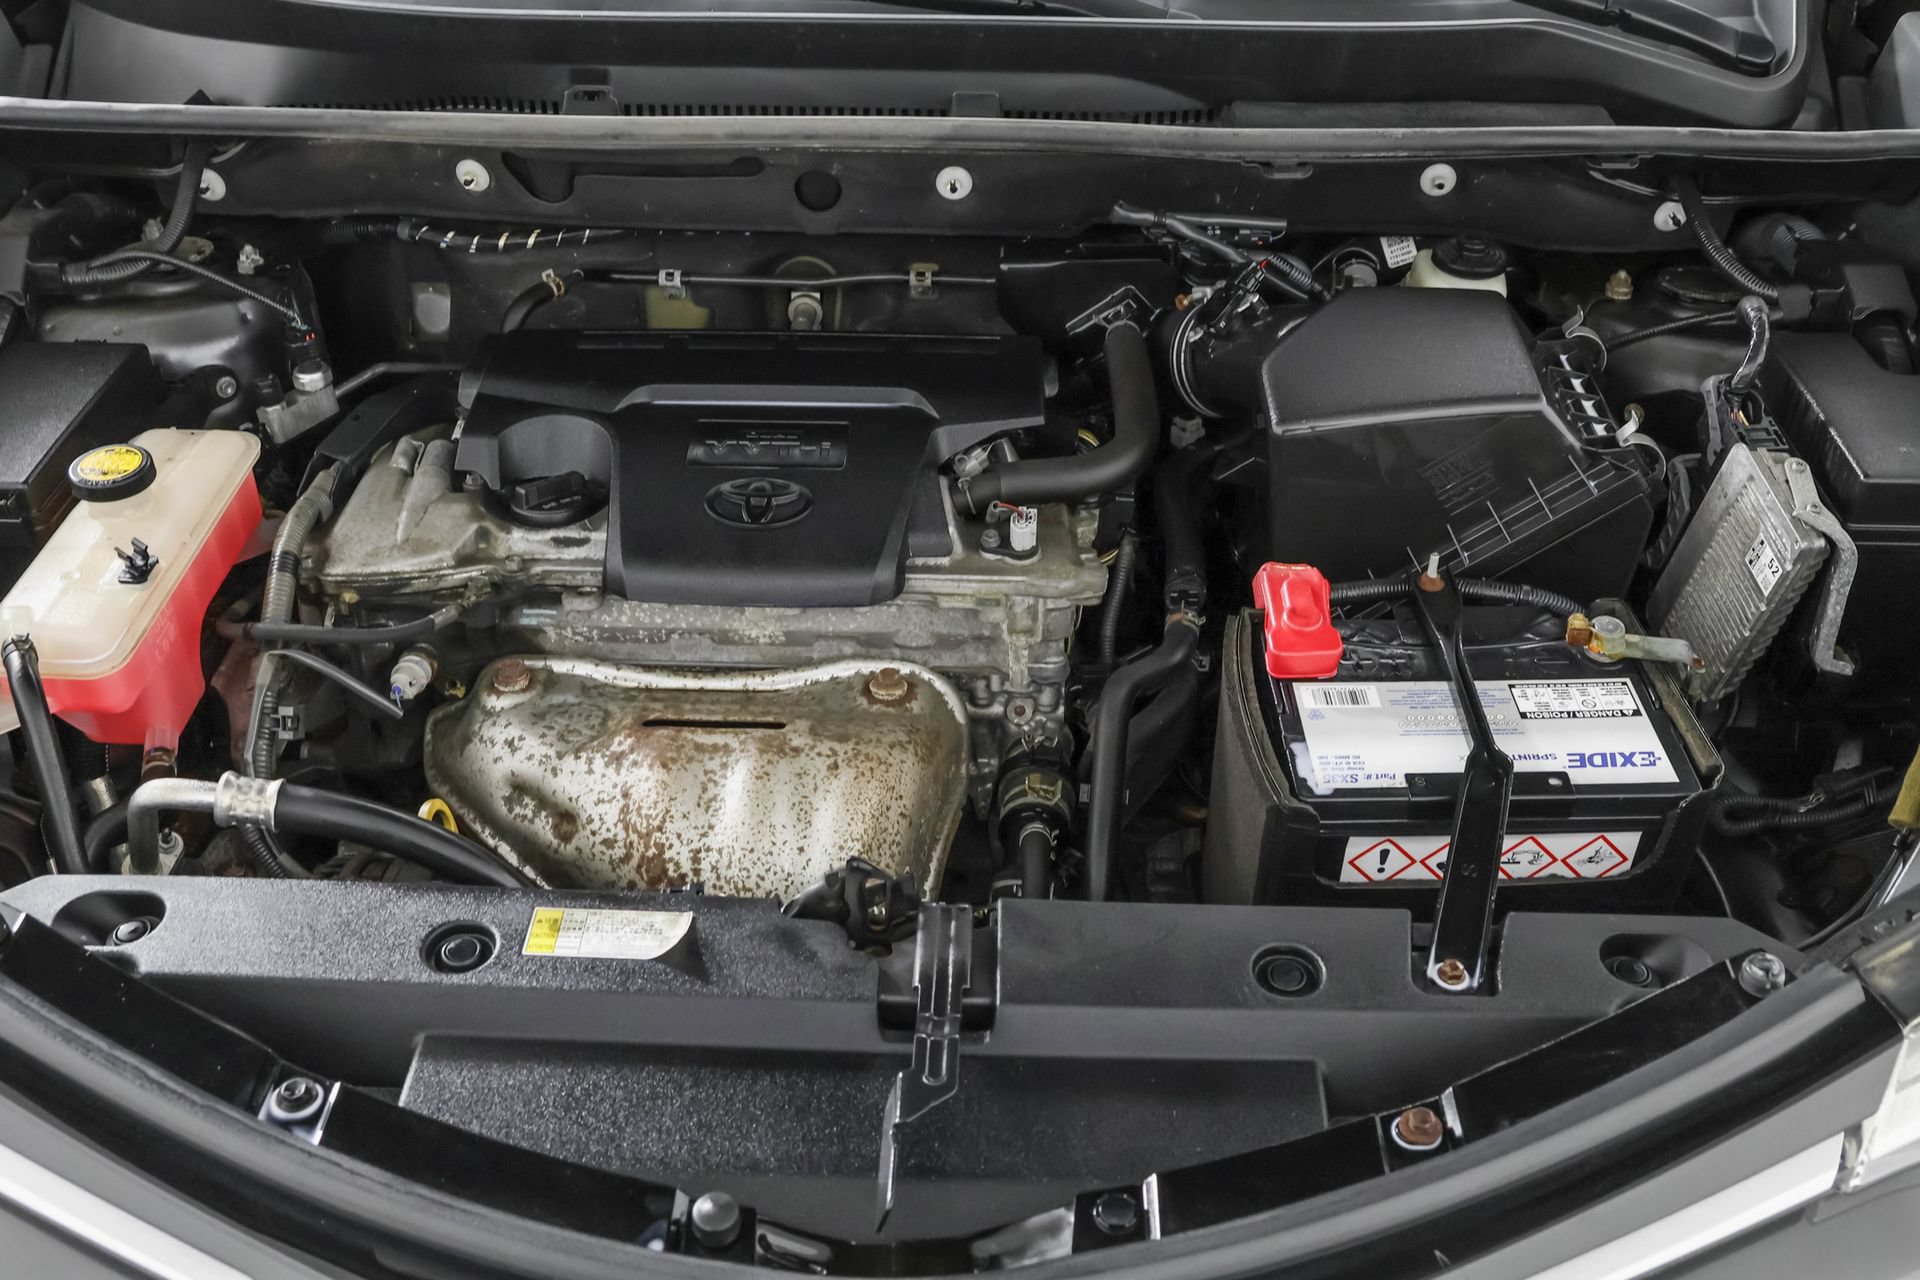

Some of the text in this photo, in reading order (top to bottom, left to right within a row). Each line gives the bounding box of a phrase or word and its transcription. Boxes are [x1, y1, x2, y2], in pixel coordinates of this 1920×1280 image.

[1526, 711, 1569, 719] POISON
[1575, 709, 1622, 718] DANGER
[1567, 751, 1661, 769] EXIDE
[1322, 773, 1359, 784] SX35
[1375, 773, 1396, 781] Part
